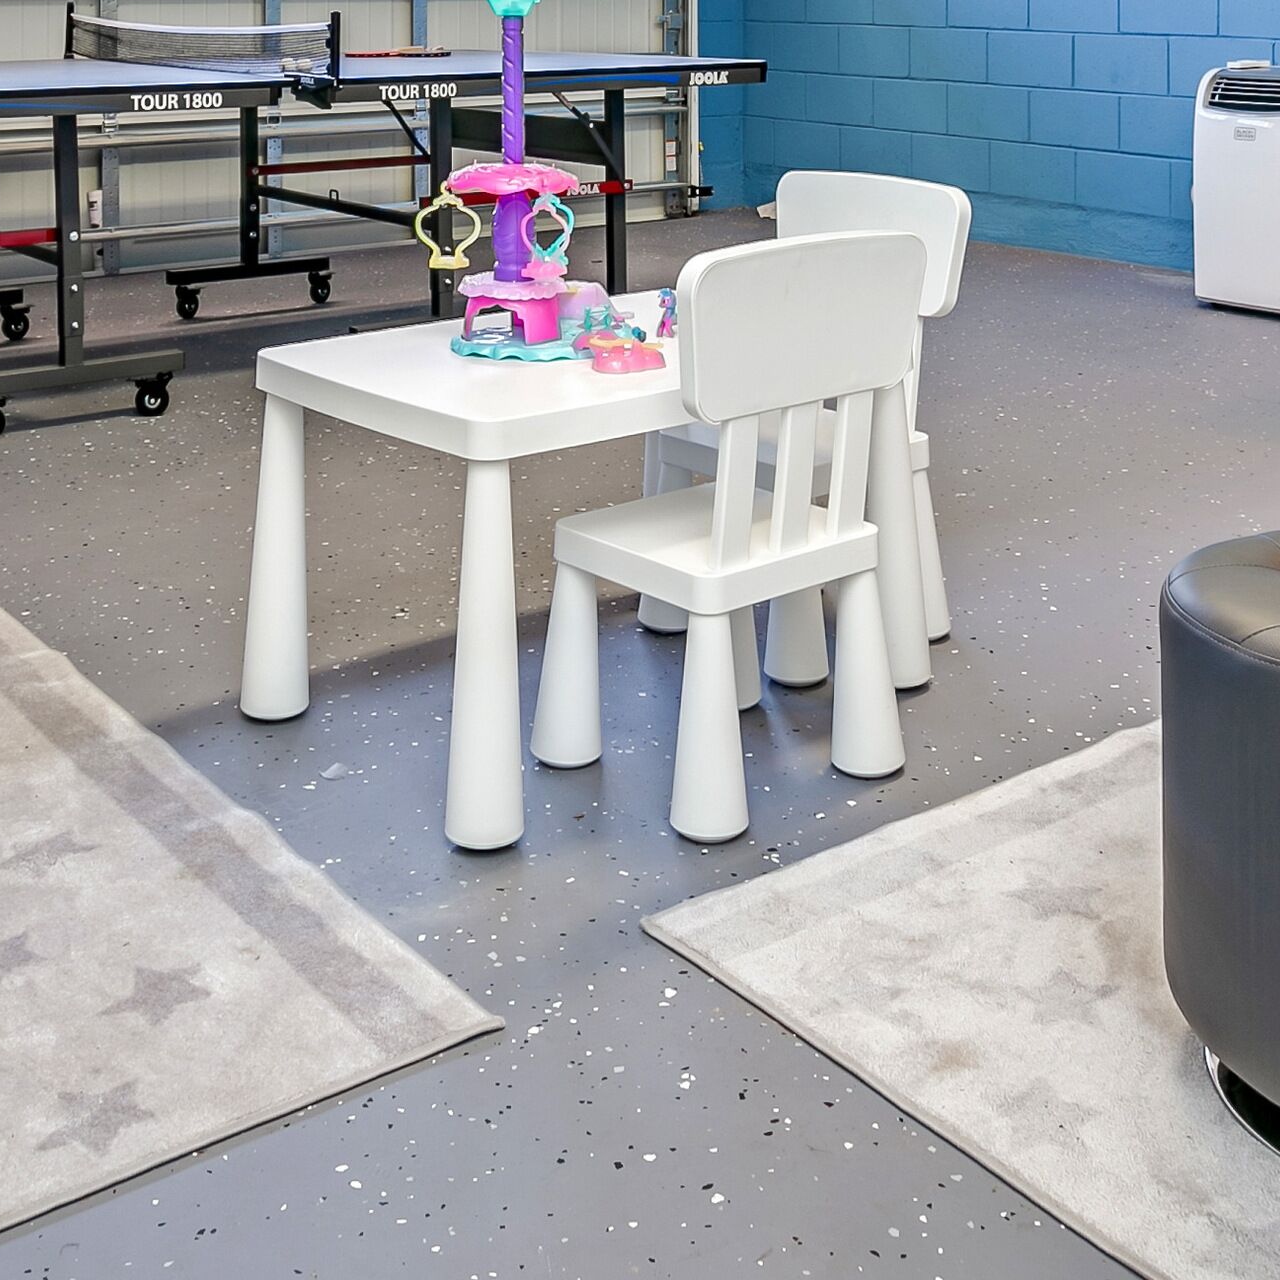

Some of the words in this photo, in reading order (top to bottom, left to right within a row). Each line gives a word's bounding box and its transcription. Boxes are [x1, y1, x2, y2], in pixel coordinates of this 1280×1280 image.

[689, 70, 729, 86] JOOLA
[379, 84, 420, 100] TOUR
[423, 83, 457, 98] 1800
[130, 93, 179, 111] TOUR
[183, 92, 223, 109] 1800
